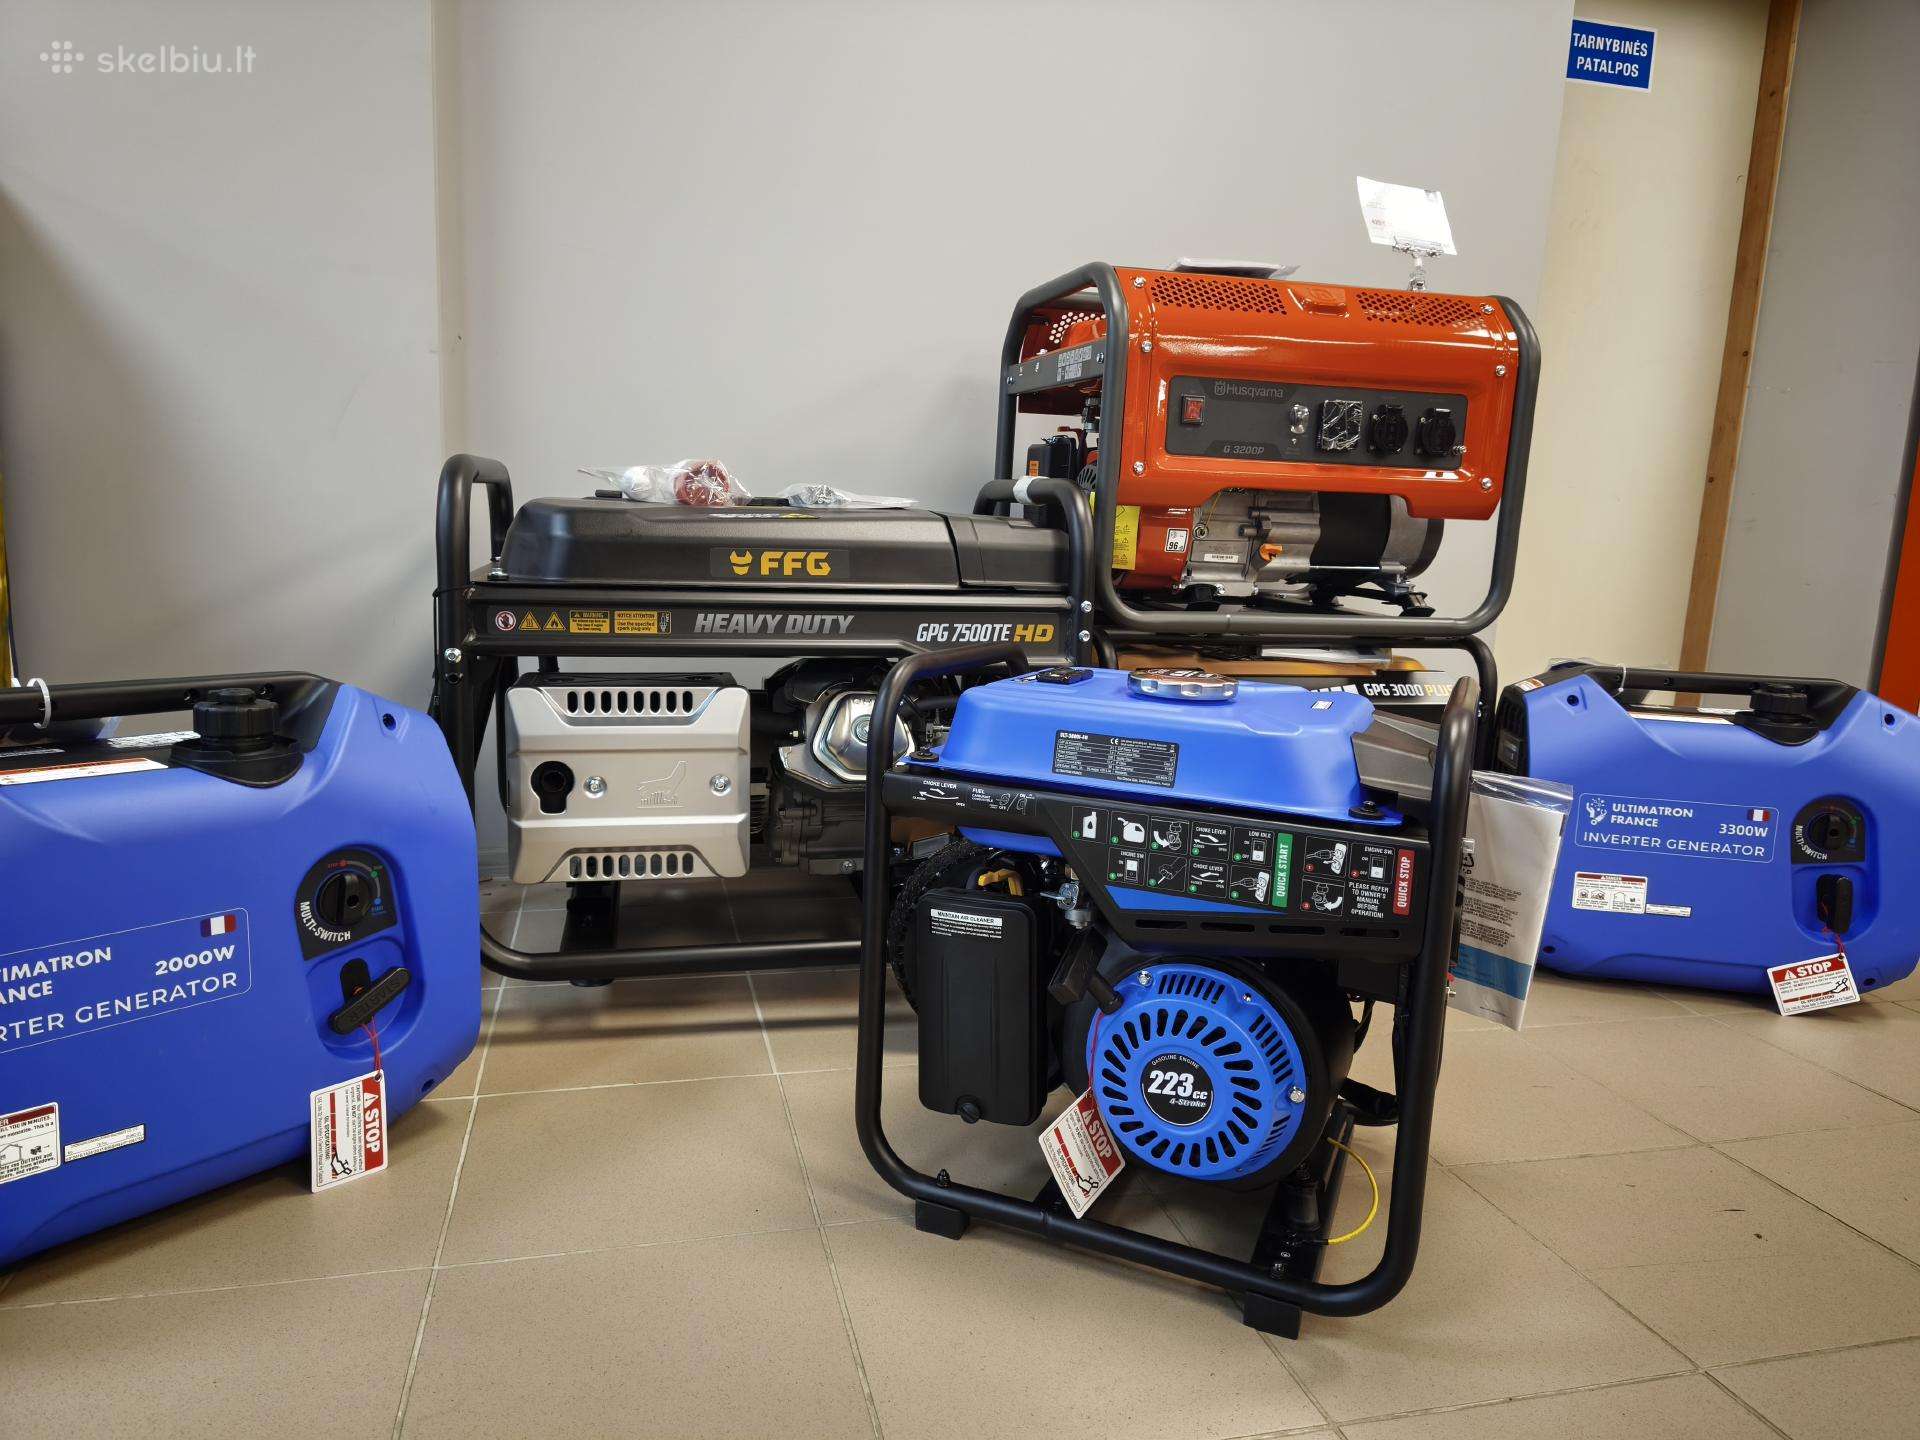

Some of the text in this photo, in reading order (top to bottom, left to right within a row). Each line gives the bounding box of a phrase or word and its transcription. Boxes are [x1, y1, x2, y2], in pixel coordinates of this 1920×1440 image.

[1572, 33, 1648, 57] TARNYBINĖS
[1576, 56, 1639, 77] PATALPOS
[1226, 383, 1284, 398] Husqvarna
[1233, 445, 1265, 455] 3200P
[1168, 541, 1178, 550] 96
[760, 551, 832, 576] FFG
[693, 613, 784, 634] HEAVY
[784, 614, 855, 634] DUTY
[916, 623, 1055, 643] GPG 7500TE HD
[1363, 683, 1391, 696] GPG
[1390, 684, 1424, 697] 3000
[1612, 803, 1694, 818] ULTIMATRON
[1611, 815, 1659, 827] FRANCE
[1719, 823, 1768, 837] 3300W
[1584, 831, 1766, 857] INVERTER GENERATOR
[1276, 843, 1289, 897] QUICK START
[1349, 882, 1389, 893] PLEASE REFER
[1397, 856, 1411, 908] QUICK STOP
[1356, 896, 1380, 905] MANUAL
[1360, 890, 1387, 899] OWNER'S
[1351, 908, 1384, 919] OPERATION!
[1357, 902, 1378, 911] BEFORE
[300, 901, 351, 942] MULTI-SWITCH
[937, 911, 960, 920] MAINTAIN
[0, 946, 112, 983] IMATRON
[155, 944, 235, 976] 2000W
[1797, 961, 1832, 977] STOP
[75, 971, 238, 1024] GENERATOR
[1152, 1054, 1200, 1069] GASOLINE ENGINE
[365, 1108, 381, 1153] STOP
[1090, 1121, 1114, 1159] STOP
